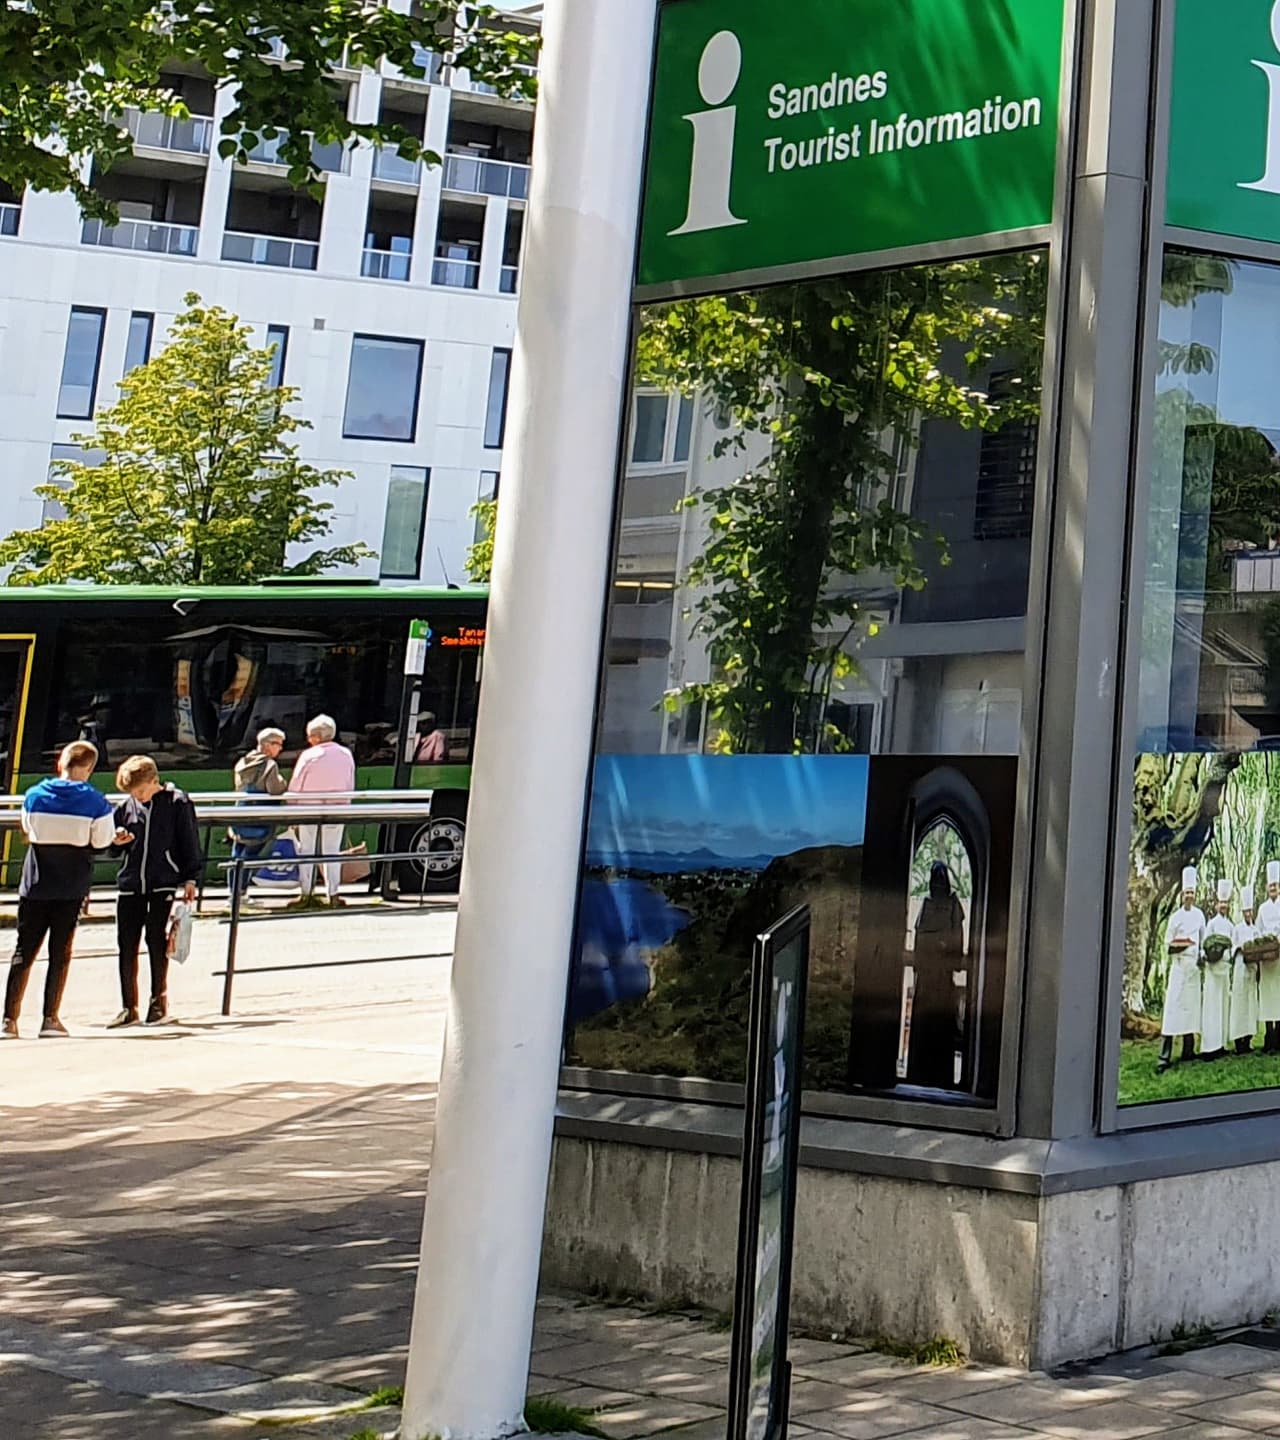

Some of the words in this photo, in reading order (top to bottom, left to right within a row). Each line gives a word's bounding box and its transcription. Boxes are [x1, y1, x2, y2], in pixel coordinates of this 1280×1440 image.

[766, 70, 888, 120] Sandnes
[764, 118, 861, 174] Tourist
[868, 95, 1042, 155] Information
